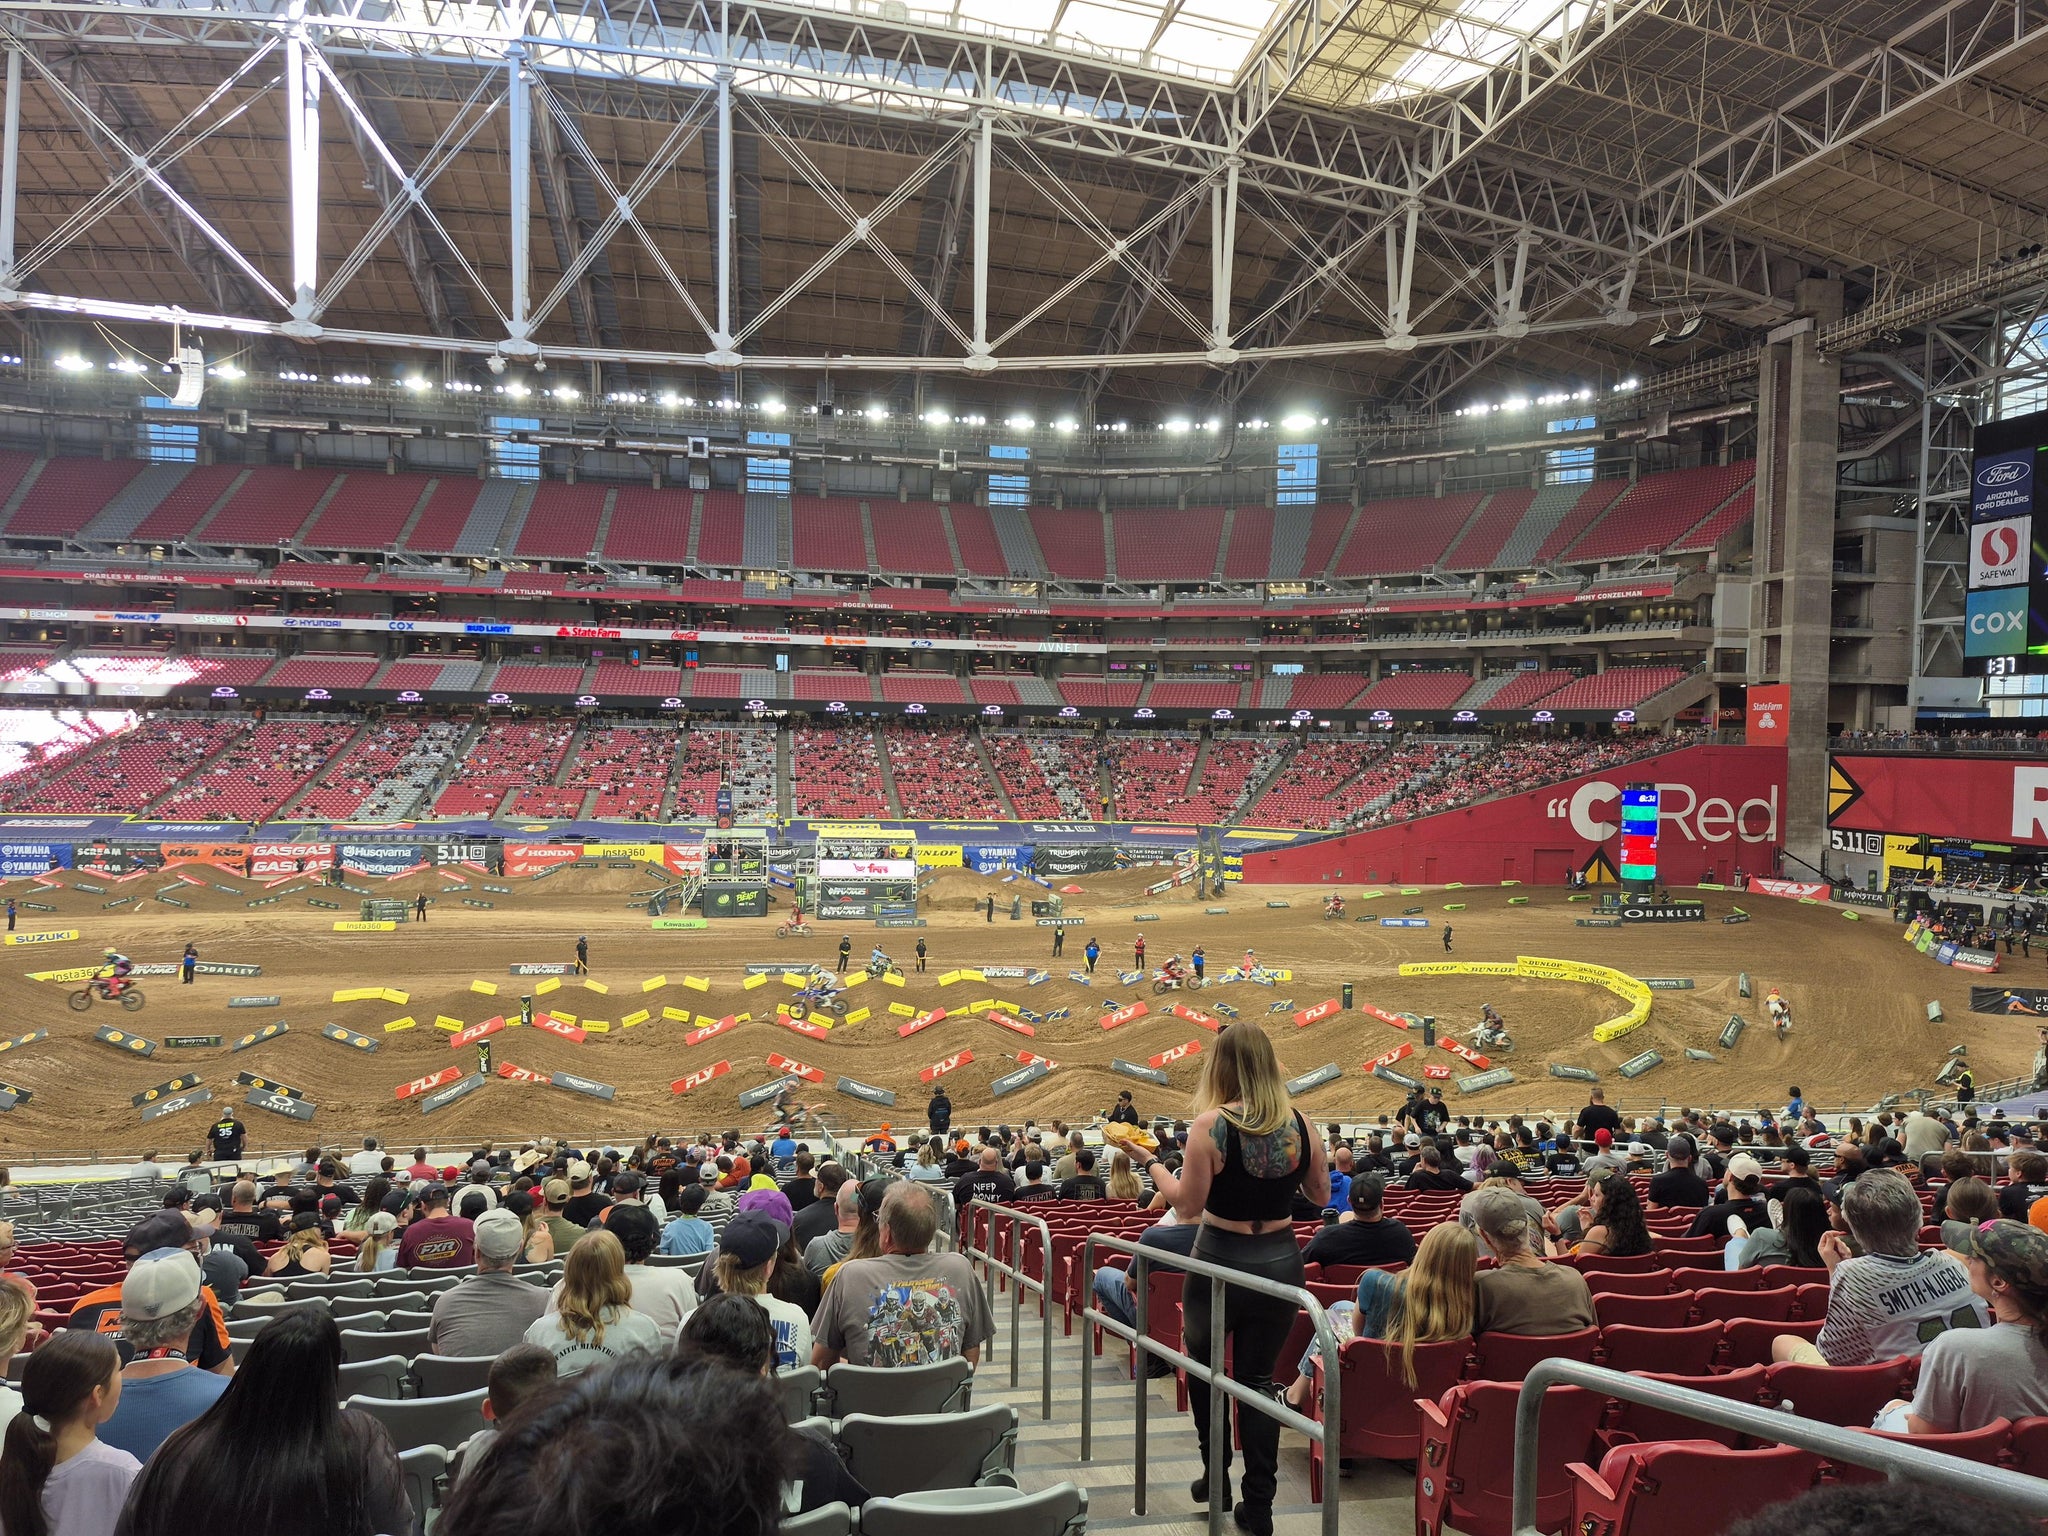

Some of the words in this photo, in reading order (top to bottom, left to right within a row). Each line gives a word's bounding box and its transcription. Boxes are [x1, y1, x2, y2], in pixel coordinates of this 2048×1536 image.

[1986, 465, 2019, 485] Ford
[1985, 489, 2018, 501] ARIZONA
[1975, 500, 1995, 511] FORD
[1996, 495, 2029, 508] DEALERS
[1980, 568, 2017, 581] SAFEWAY
[1573, 594, 1596, 602] JIMMY
[1597, 591, 1643, 600] CONZELMAN
[193, 615, 234, 623] SAFEWAY
[299, 619, 342, 627] HYUNDAI
[1970, 610, 2024, 635] COX
[389, 622, 414, 630] COX
[1038, 643, 1081, 652] AVNET
[1986, 656, 2016, 675] 1:37
[1656, 783, 1778, 843] Red
[164, 824, 222, 833] YAMAHA
[1831, 829, 1865, 853] 5.11
[12, 846, 51, 856] YAMAHA
[77, 847, 122, 856] SCREAM
[168, 848, 200, 857] KTM
[212, 848, 243, 857] KTM
[253, 846, 331, 856] GASGAS
[354, 847, 411, 858] Husqvarna
[437, 846, 469, 860] 5.11
[527, 849, 576, 857] HONDA
[603, 847, 646, 857] Insta360
[987, 848, 1017, 857] YAMAHA
[12, 861, 51, 871] YAMAHA
[1764, 880, 1824, 895] FLY
[737, 891, 759, 902] BEAST
[1844, 890, 1883, 902] MONSTER
[1645, 909, 1702, 917] OAKLEY
[346, 922, 382, 930] Insta360
[15, 932, 71, 943] SUZUKI
[1528, 960, 1563, 968] DUNLOP
[209, 967, 255, 975] OAKLEY
[1578, 975, 1611, 985] DUNLOP
[1112, 1006, 1136, 1022] FLY
[1185, 1009, 1209, 1022] FLY
[1305, 1003, 1329, 1020] FLY
[1376, 1009, 1398, 1021] FLY
[545, 1020, 575, 1034] FLY
[789, 1018, 815, 1031] FLY
[909, 1013, 934, 1029] FLY
[1000, 1016, 1024, 1028] FLY
[463, 1023, 491, 1040] FLY
[697, 1021, 720, 1038] FLY
[1162, 1044, 1188, 1062] FLY
[1376, 1049, 1402, 1065] FLY
[1452, 1046, 1481, 1061] FLY
[780, 1058, 813, 1076] FLY
[933, 1054, 960, 1077] FLY
[1125, 1063, 1152, 1074] TRIUMPH
[686, 1067, 715, 1089] FLY
[1002, 1069, 1029, 1085] TRIUMPH
[1295, 1070, 1323, 1085] TRIUMPH
[1430, 1068, 1448, 1077] FLY
[410, 1071, 443, 1093] FLY
[566, 1077, 594, 1090] TRIUMPH
[433, 1086, 463, 1103] TRIUMPH
[751, 1081, 780, 1099] TRIUMPH
[849, 1082, 877, 1097] TRIUMPH
[261, 1099, 297, 1115] OAKLEY
[219, 1127, 233, 1137] 35
[973, 1182, 997, 1194] NEED
[973, 1193, 1002, 1203] MONEY
[420, 1240, 455, 1255] FXR
[1878, 1265, 1969, 1315] SMITH-NJIGBA
[555, 1343, 578, 1361] FAITH
